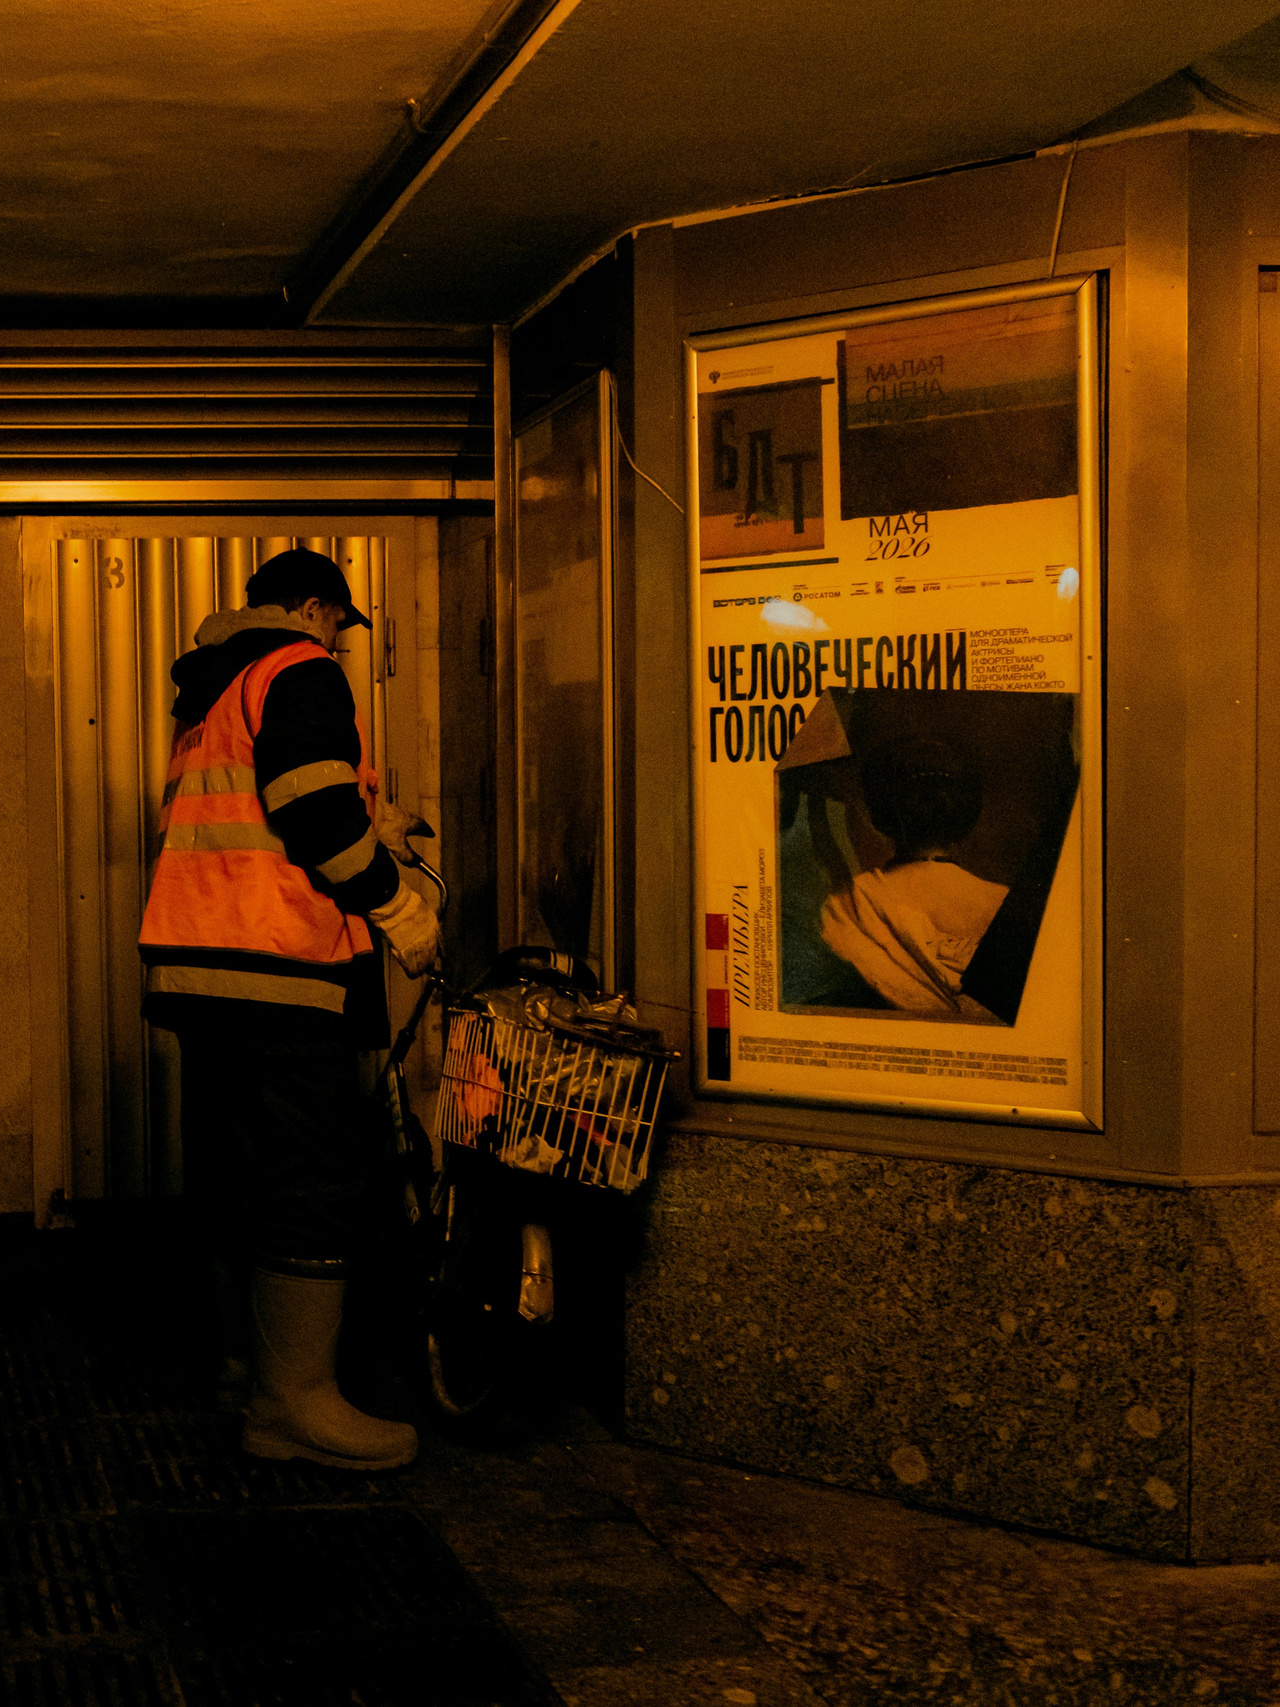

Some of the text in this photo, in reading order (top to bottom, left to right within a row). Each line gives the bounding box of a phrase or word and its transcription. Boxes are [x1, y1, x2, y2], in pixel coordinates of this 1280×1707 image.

[866, 354, 944, 383] МАЛАЯ
[866, 378, 944, 405] СЦЕНА
[869, 512, 928, 538] МАЯ
[864, 535, 935, 562] 2026
[102, 556, 125, 589] 3
[803, 591, 841, 600] РОСАТОМ
[969, 628, 1029, 638] МОНООПЕРА
[969, 633, 1073, 648] ДЛЯ ДРАМАТИЧЕСКОЙ
[971, 647, 1015, 657] АКТРИСЫ
[707, 628, 967, 701] ЧЕЛОВЕЧЕСКИЙ
[971, 654, 1045, 666] И ФОРТЕПИАНО
[971, 663, 1035, 674] ПО МОТИВАМ
[971, 671, 1046, 683] ОДНОИМЕННОЙ
[971, 681, 1065, 691] ПЬЕСЫ ЖАНА КОКТО
[732, 884, 750, 1008] ПРЕМЬЕРА
